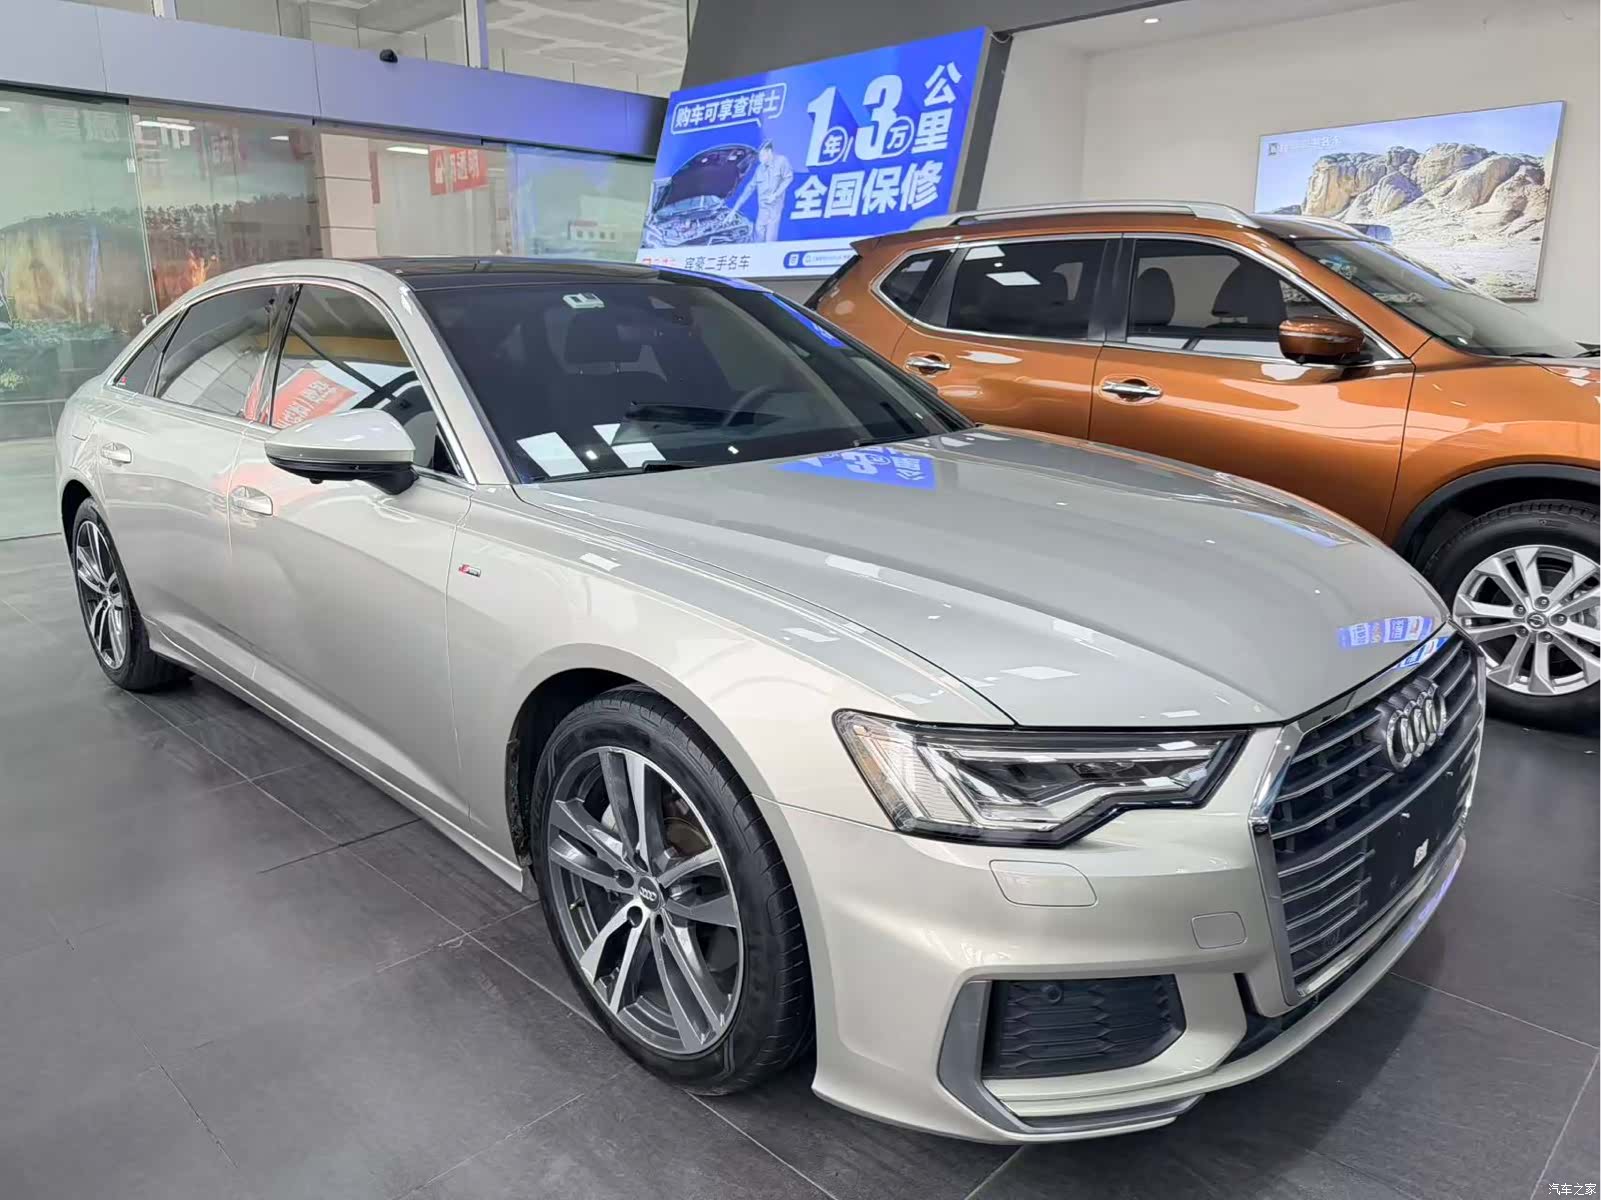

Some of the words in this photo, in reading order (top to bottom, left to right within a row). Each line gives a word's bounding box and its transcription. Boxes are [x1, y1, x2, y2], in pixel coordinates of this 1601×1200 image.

[674, 89, 781, 128] 购车可享查博士
[911, 61, 963, 154] 公里
[789, 159, 944, 220] 全国保修
